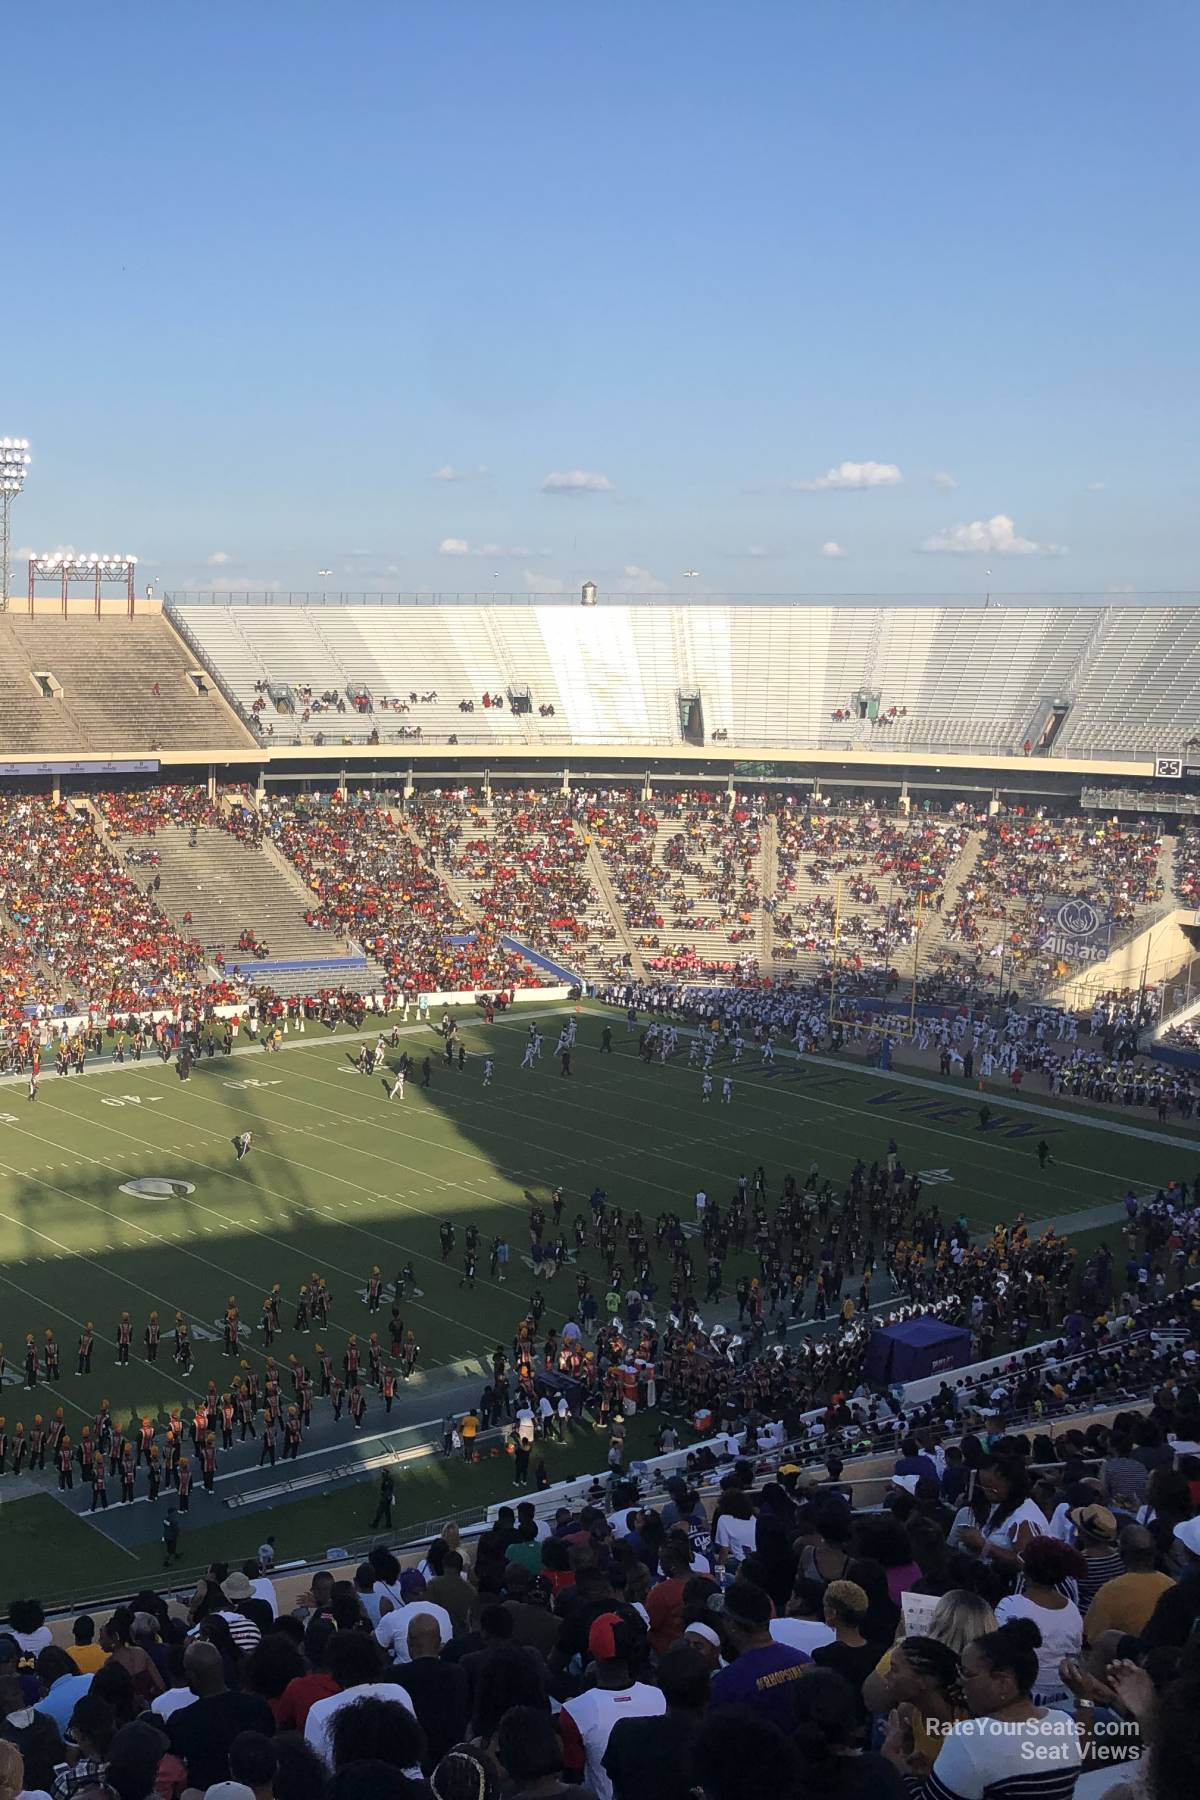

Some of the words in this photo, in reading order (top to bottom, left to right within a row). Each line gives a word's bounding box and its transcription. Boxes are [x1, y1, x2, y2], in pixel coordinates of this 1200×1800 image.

[1159, 761, 1178, 775] 25
[1040, 937, 1107, 961] Allstate
[101, 1094, 142, 1107] 40
